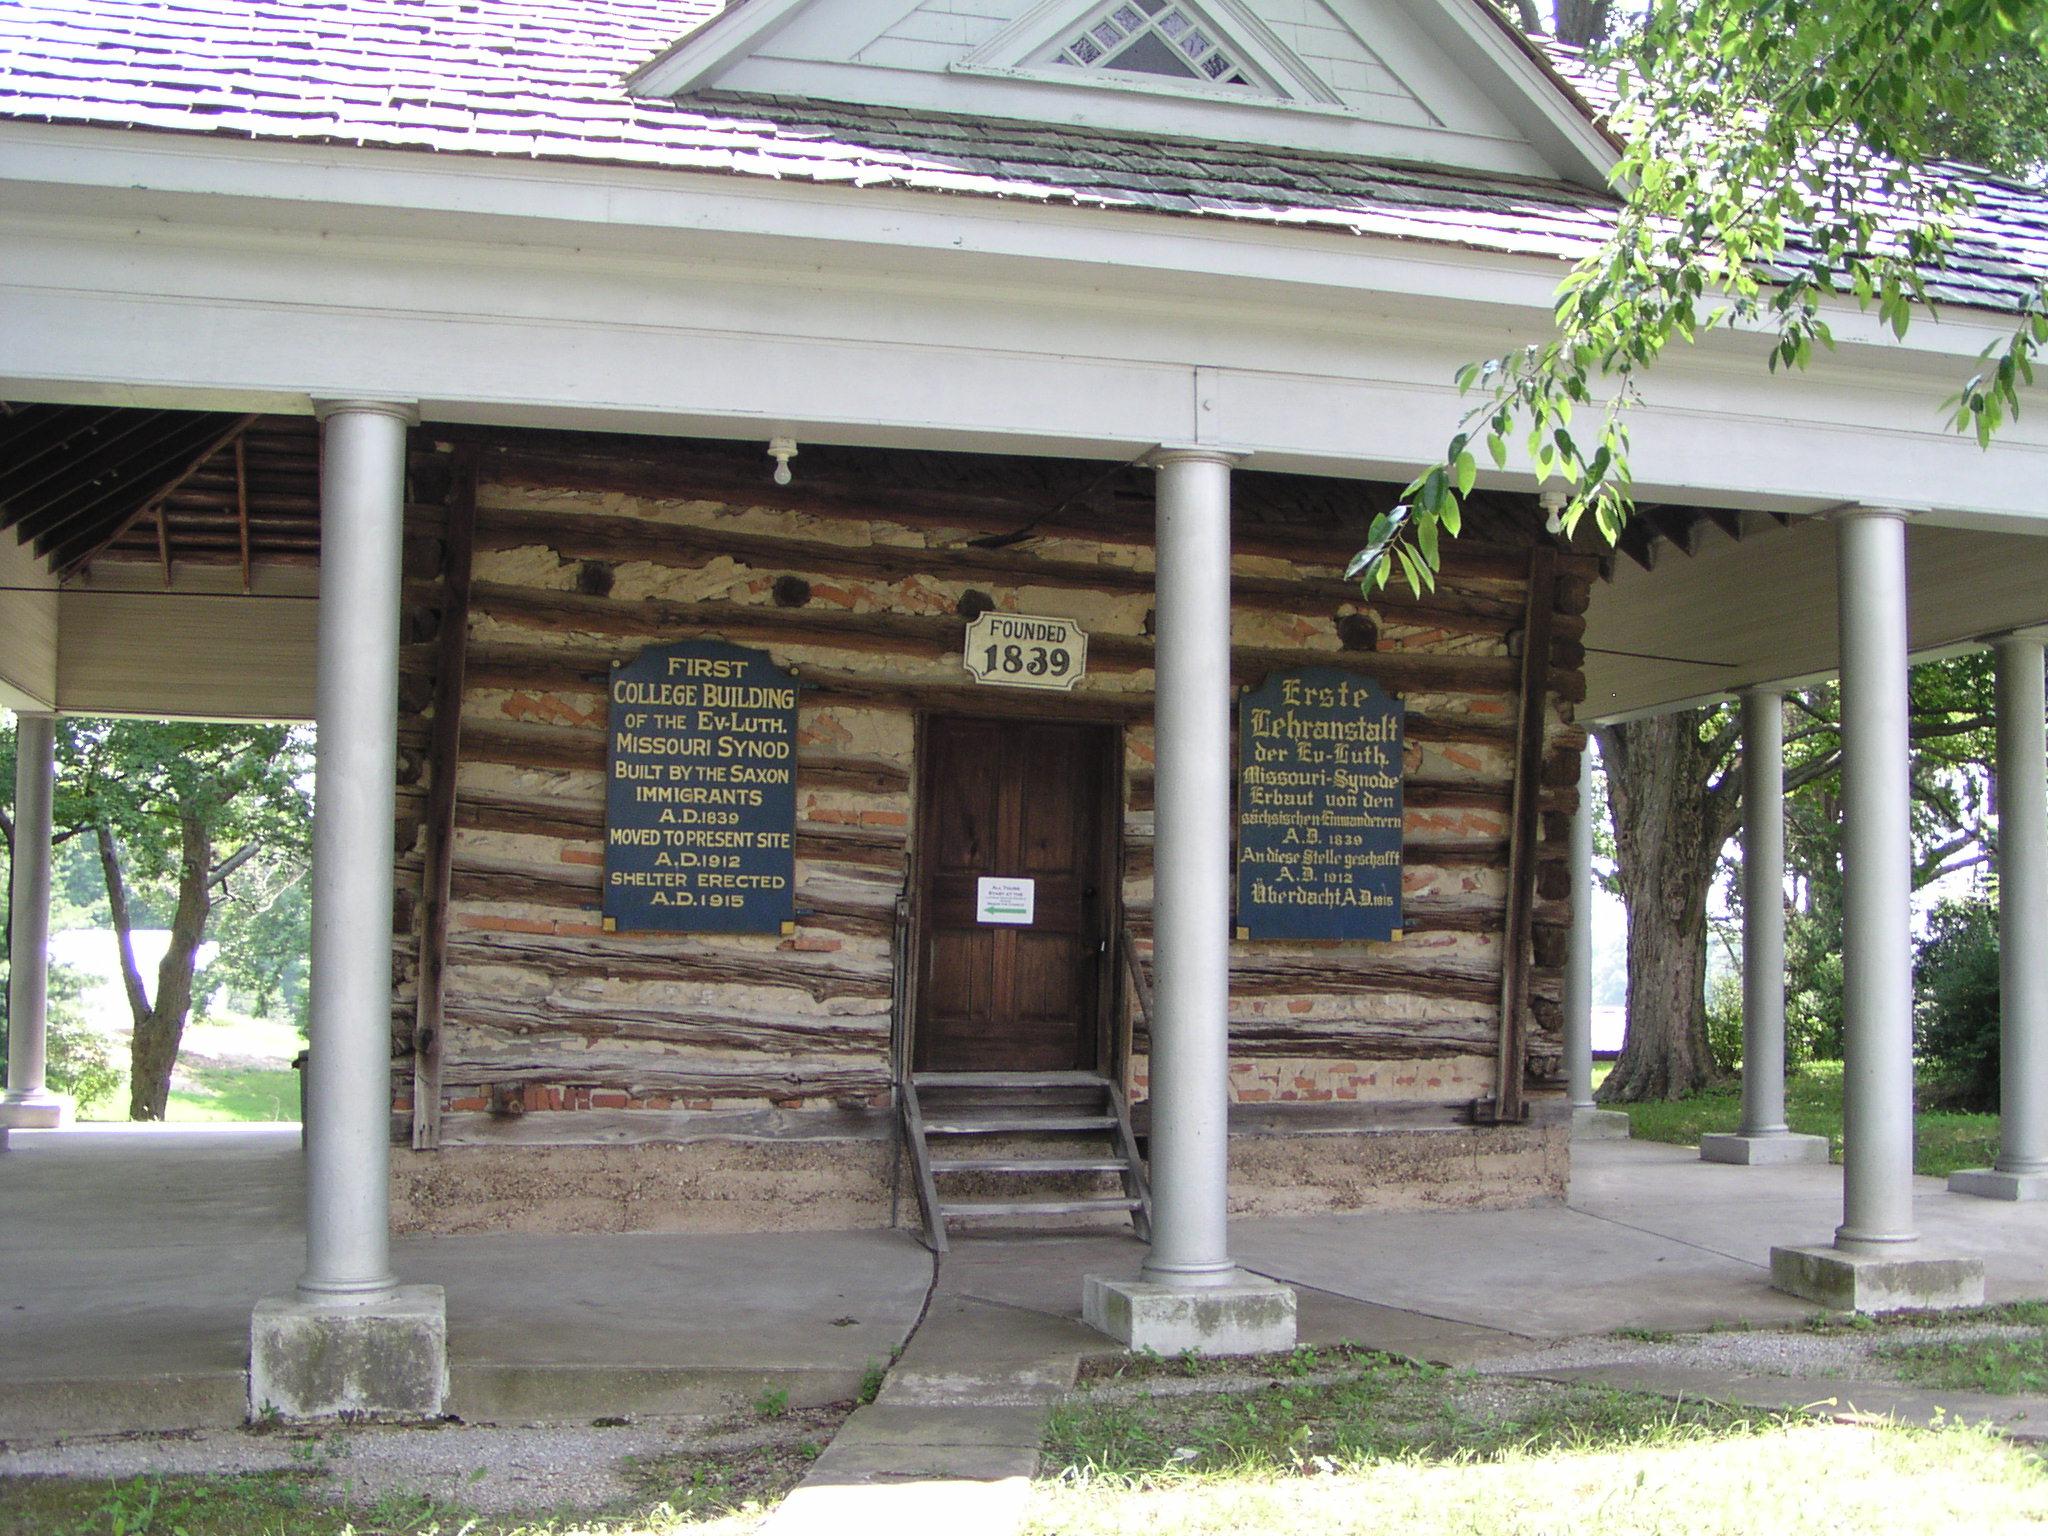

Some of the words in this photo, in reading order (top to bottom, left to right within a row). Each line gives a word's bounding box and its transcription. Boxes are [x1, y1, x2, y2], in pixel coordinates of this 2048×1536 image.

[990, 619, 1066, 643] FOUNDED
[668, 657, 748, 678] FIRST
[982, 645, 1070, 676] 1839
[614, 680, 697, 706] COLLEGE
[703, 683, 794, 709] BUILDING
[1282, 679, 1368, 708] Erste
[625, 713, 647, 729] OF
[654, 714, 686, 729] THE
[1251, 708, 1398, 742] Lehranstalt
[617, 733, 711, 756] MISSOURI
[718, 736, 789, 759] SYNOD
[1254, 742, 1288, 762] der
[615, 761, 664, 779] BUILT
[669, 765, 692, 781] BY
[696, 766, 726, 782] THE
[730, 765, 789, 784] SAXON
[636, 787, 762, 806] IMMIGRANTS
[1250, 786, 1313, 806] Erbaut
[1326, 794, 1358, 807] von
[1363, 790, 1394, 808] den
[610, 829, 660, 846] MOVED
[664, 830, 684, 846] TO
[686, 831, 754, 847] PRESENT
[757, 833, 790, 848] SITE
[1329, 835, 1363, 845] 1839
[1241, 849, 1264, 863] An
[1266, 849, 1300, 864] diese
[1302, 850, 1341, 866] Stelle
[1344, 850, 1400, 869] geschafft
[611, 873, 687, 887] SHELTER
[698, 874, 785, 889] ERECTED
[1324, 873, 1353, 883] 1912
